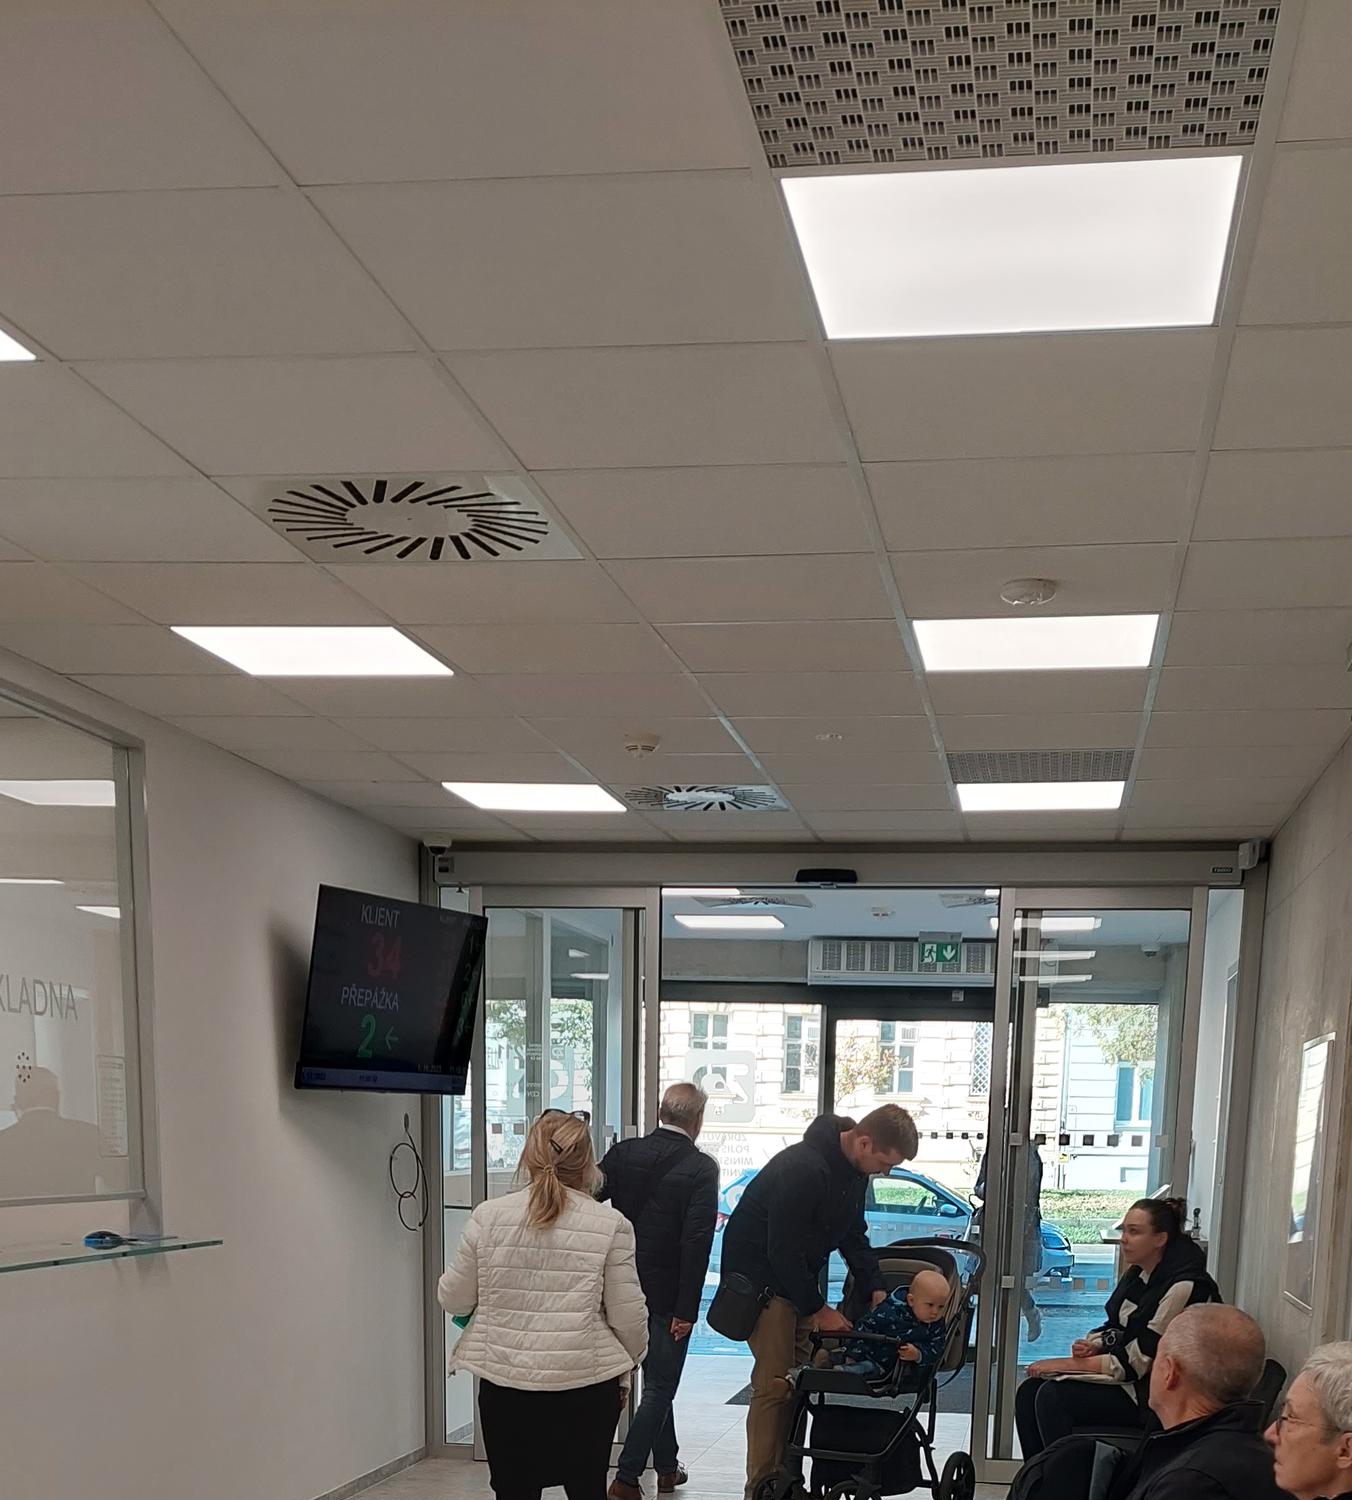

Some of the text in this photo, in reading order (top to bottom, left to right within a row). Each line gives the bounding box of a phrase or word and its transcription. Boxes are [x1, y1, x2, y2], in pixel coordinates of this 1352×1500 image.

[360, 904, 400, 928] KLIENT
[367, 931, 402, 979] 34
[340, 983, 400, 1011] PŘEPÁŽKA
[354, 1013, 376, 1059] 2
